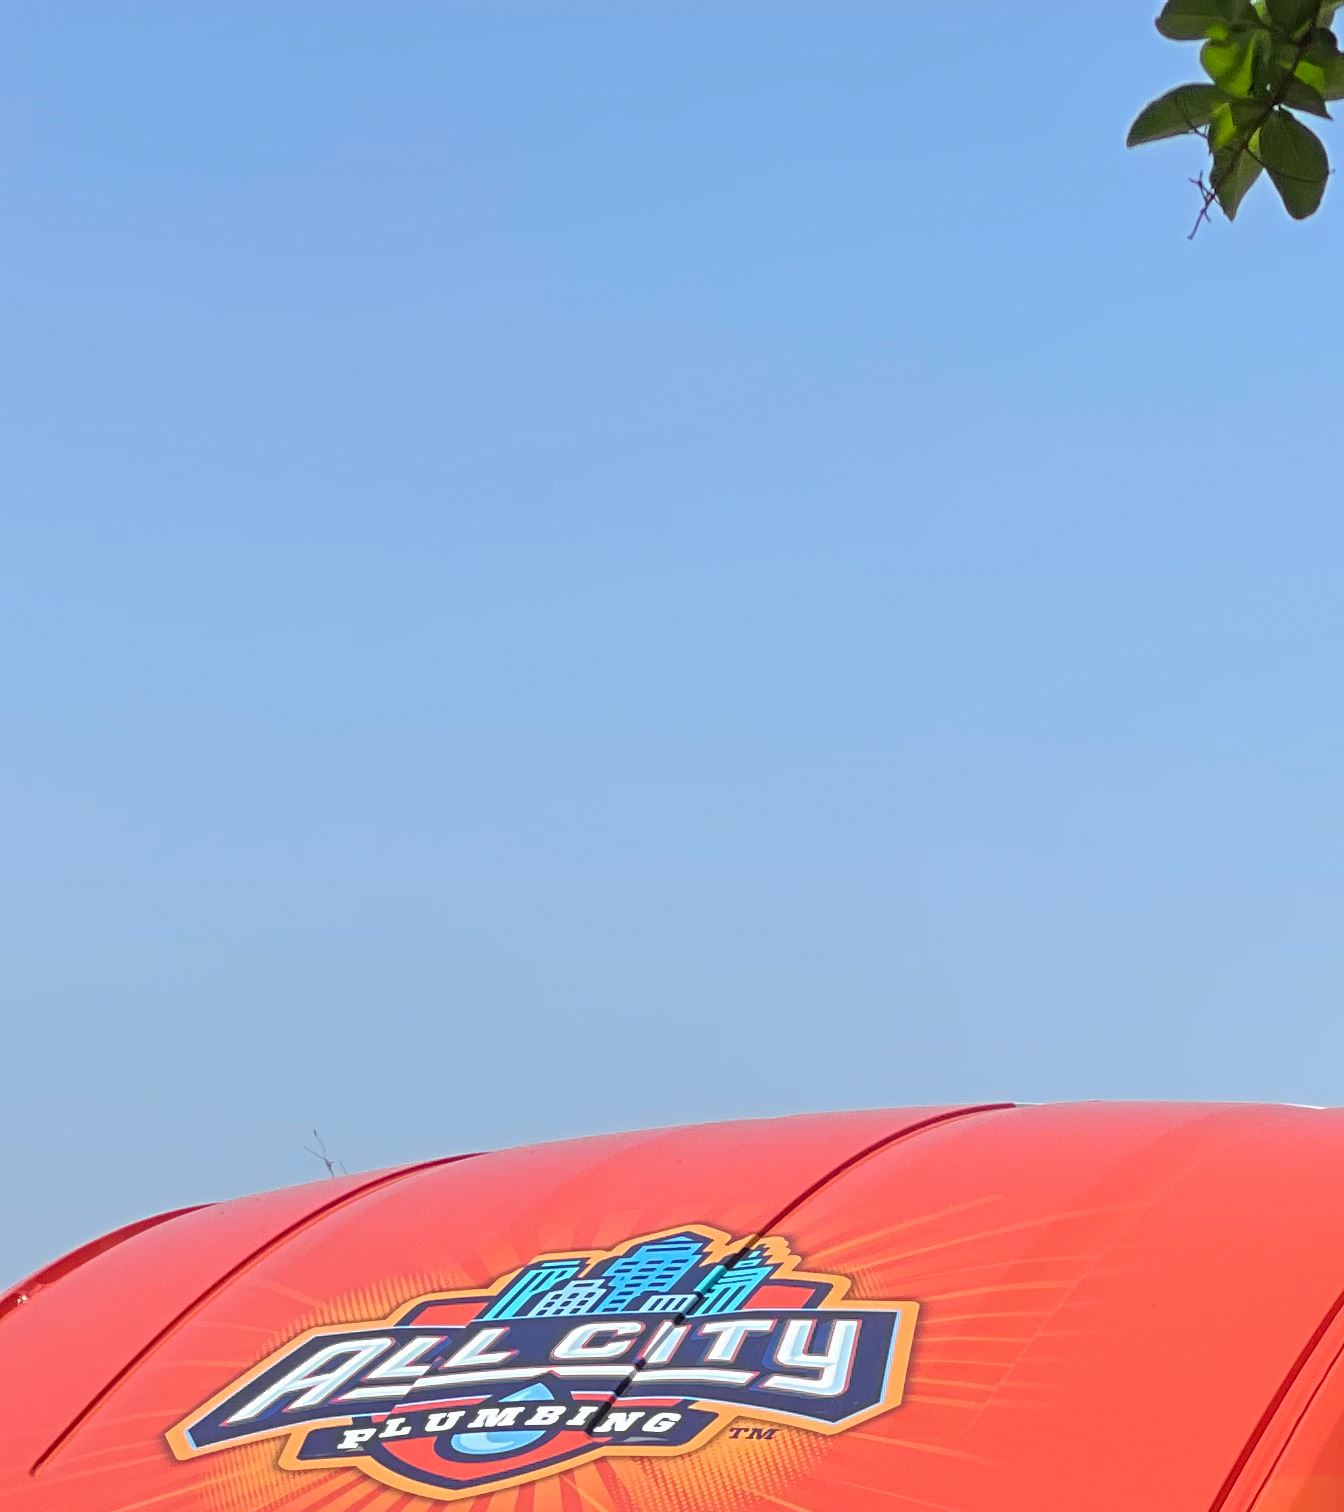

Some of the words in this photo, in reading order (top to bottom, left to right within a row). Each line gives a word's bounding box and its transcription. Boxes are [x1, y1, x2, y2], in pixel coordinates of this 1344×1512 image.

[226, 1325, 518, 1427] ALL
[548, 1317, 864, 1396] CITY
[337, 1403, 681, 1452] PLUMBING
[729, 1427, 779, 1440] TM
